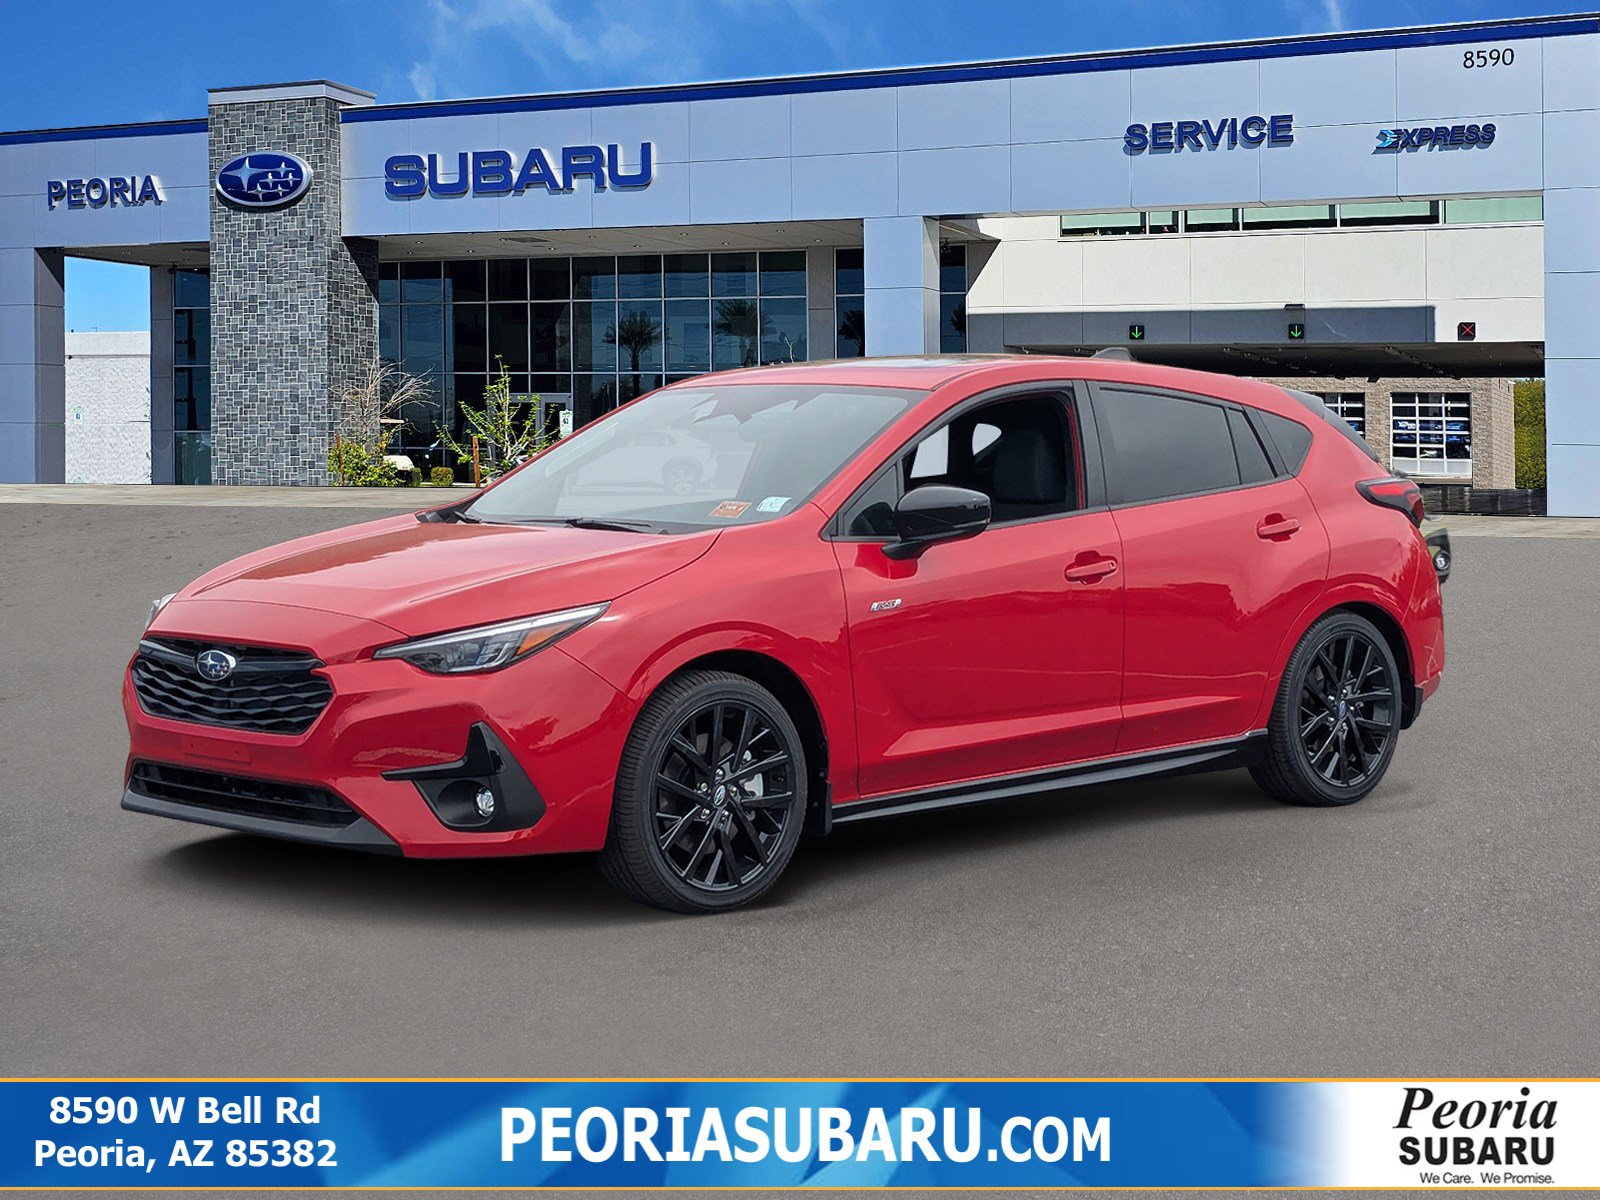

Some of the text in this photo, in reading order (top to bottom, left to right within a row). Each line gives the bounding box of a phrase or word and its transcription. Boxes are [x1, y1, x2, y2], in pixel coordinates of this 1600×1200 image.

[1463, 48, 1514, 69] 8590
[1125, 114, 1294, 152] SERVICE
[1375, 123, 1496, 149] EXPRESS
[385, 142, 652, 197] SUBARU
[47, 175, 163, 208] PEORIA
